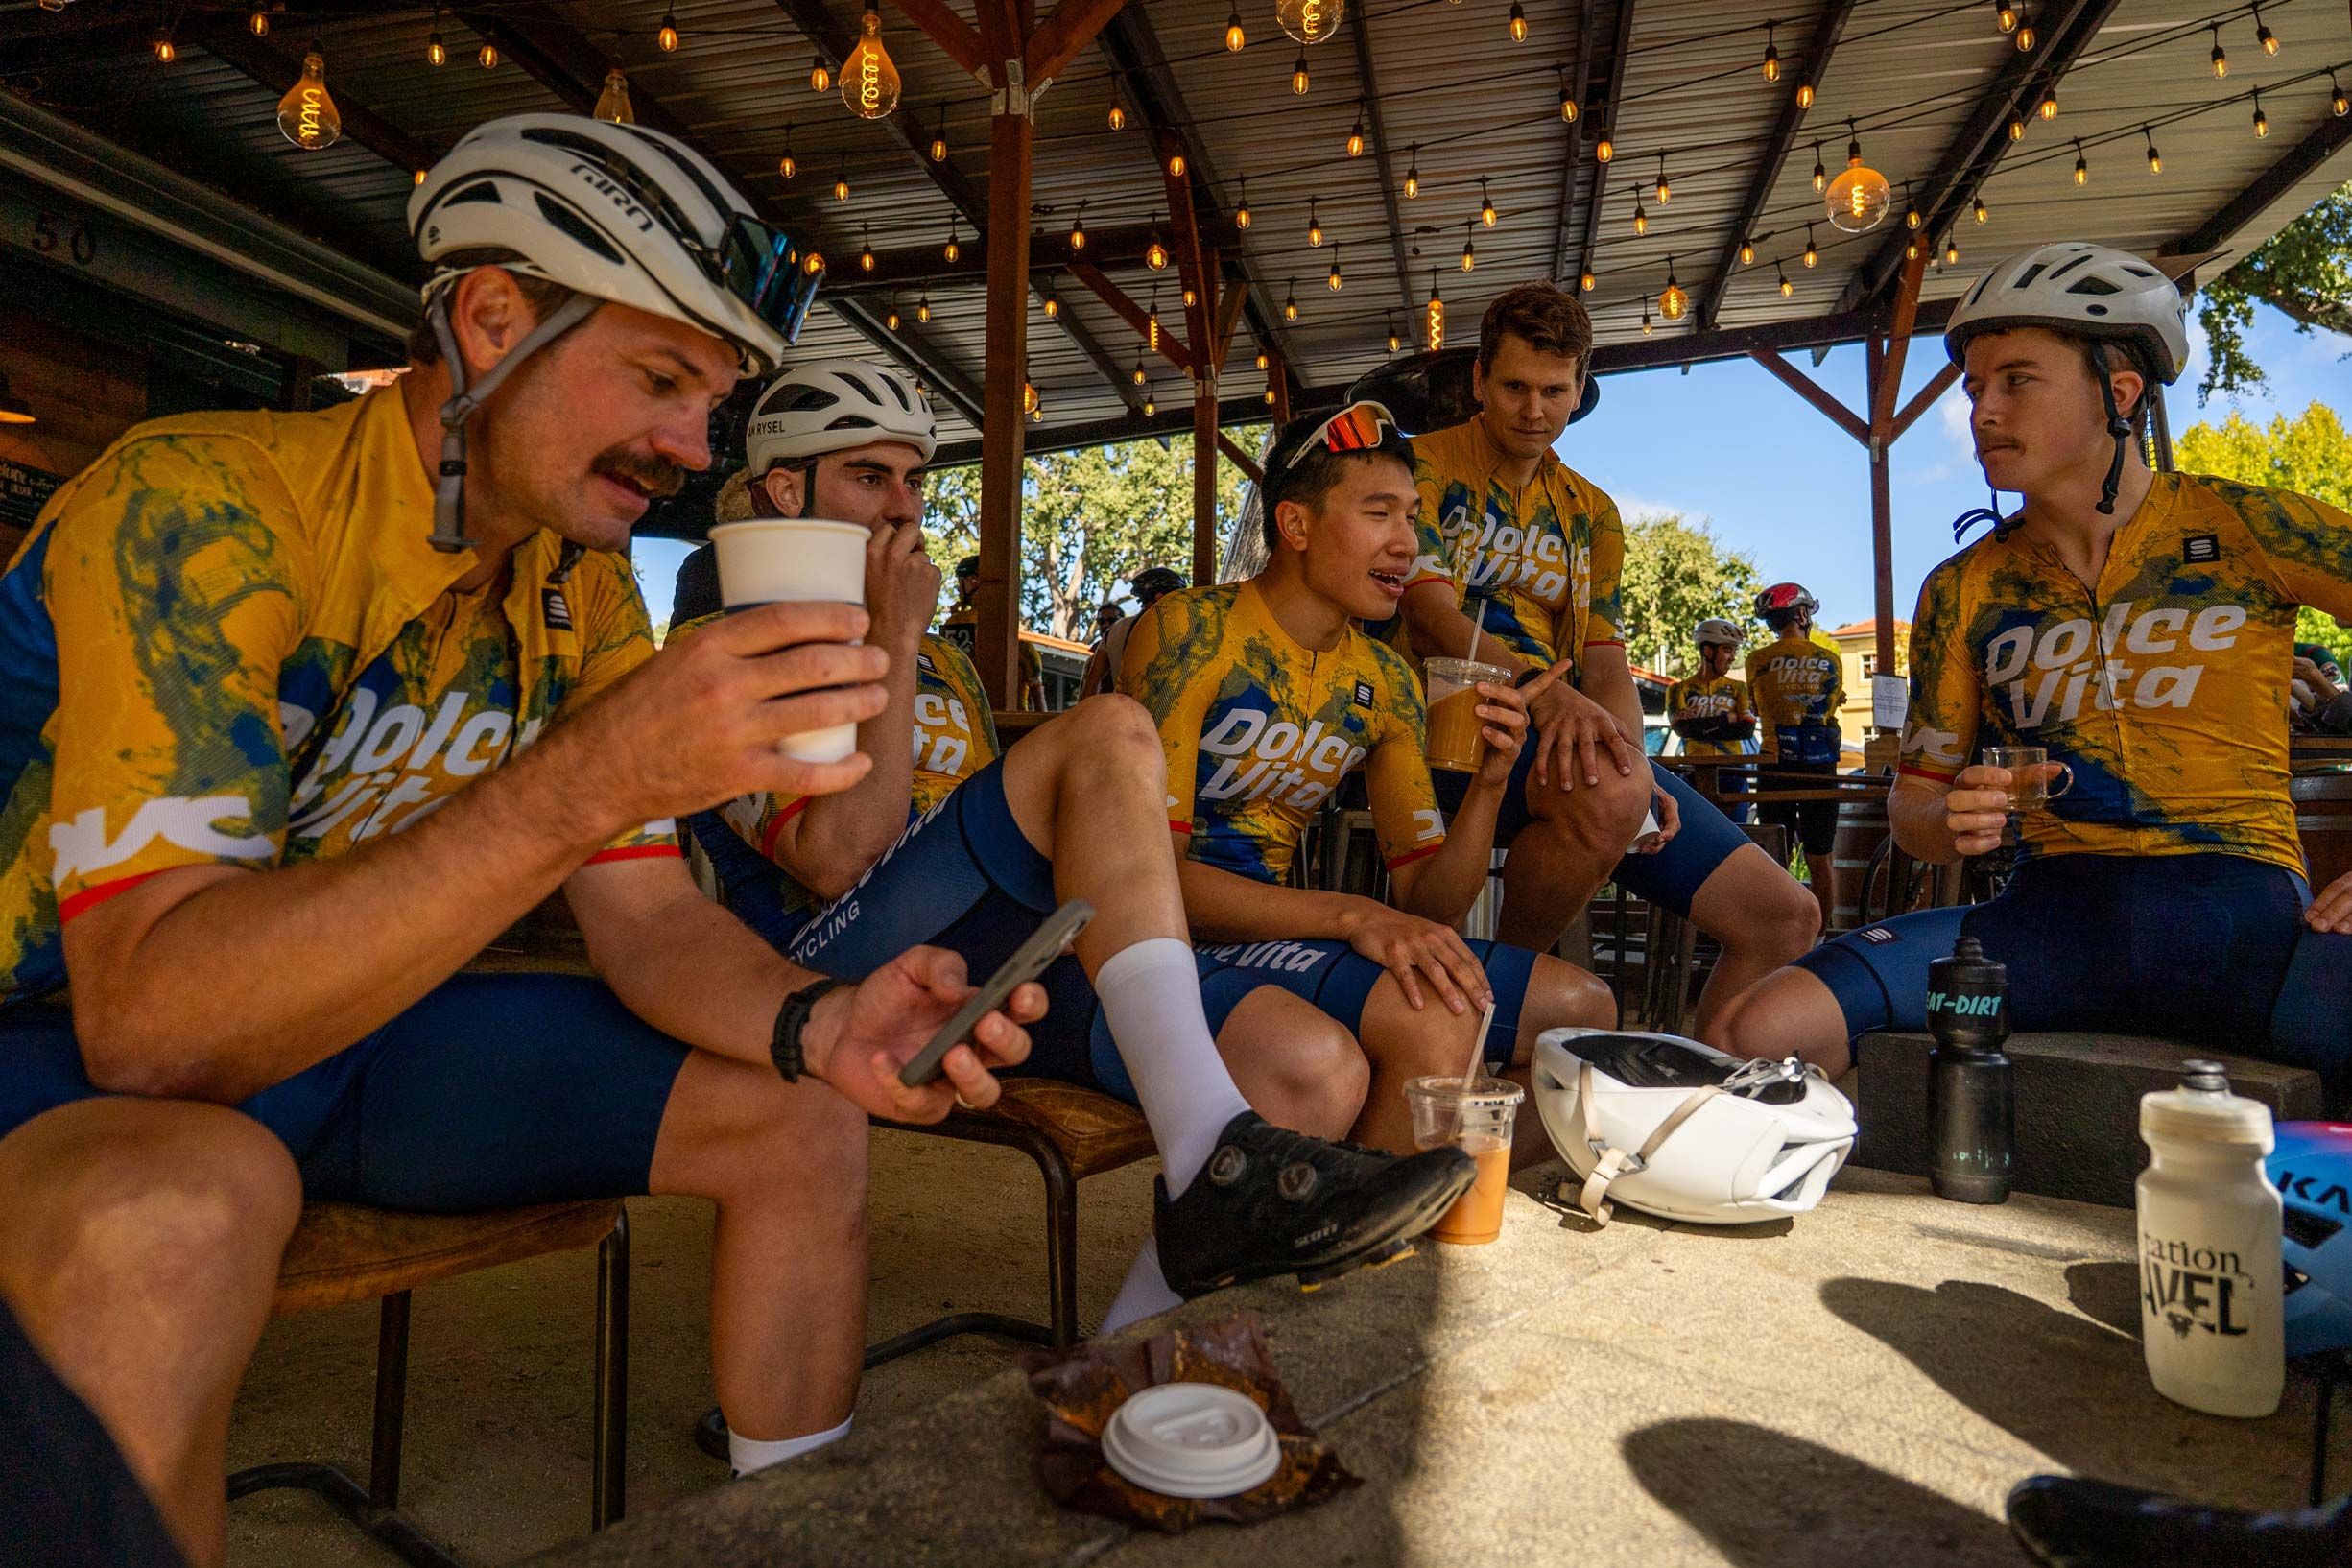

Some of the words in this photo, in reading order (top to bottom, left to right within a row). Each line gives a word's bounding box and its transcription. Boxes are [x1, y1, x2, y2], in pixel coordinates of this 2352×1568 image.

[757, 420, 786, 435] RYSEL
[1467, 550, 1567, 602] Vita
[1770, 656, 1830, 671] Dolce
[1985, 602, 2247, 686] Dolce
[1777, 671, 1822, 684] Vita
[2009, 659, 2205, 729] Vita
[1200, 708, 1367, 779] Dolce
[1199, 758, 1334, 811] Vita
[1235, 940, 1328, 973] Vita
